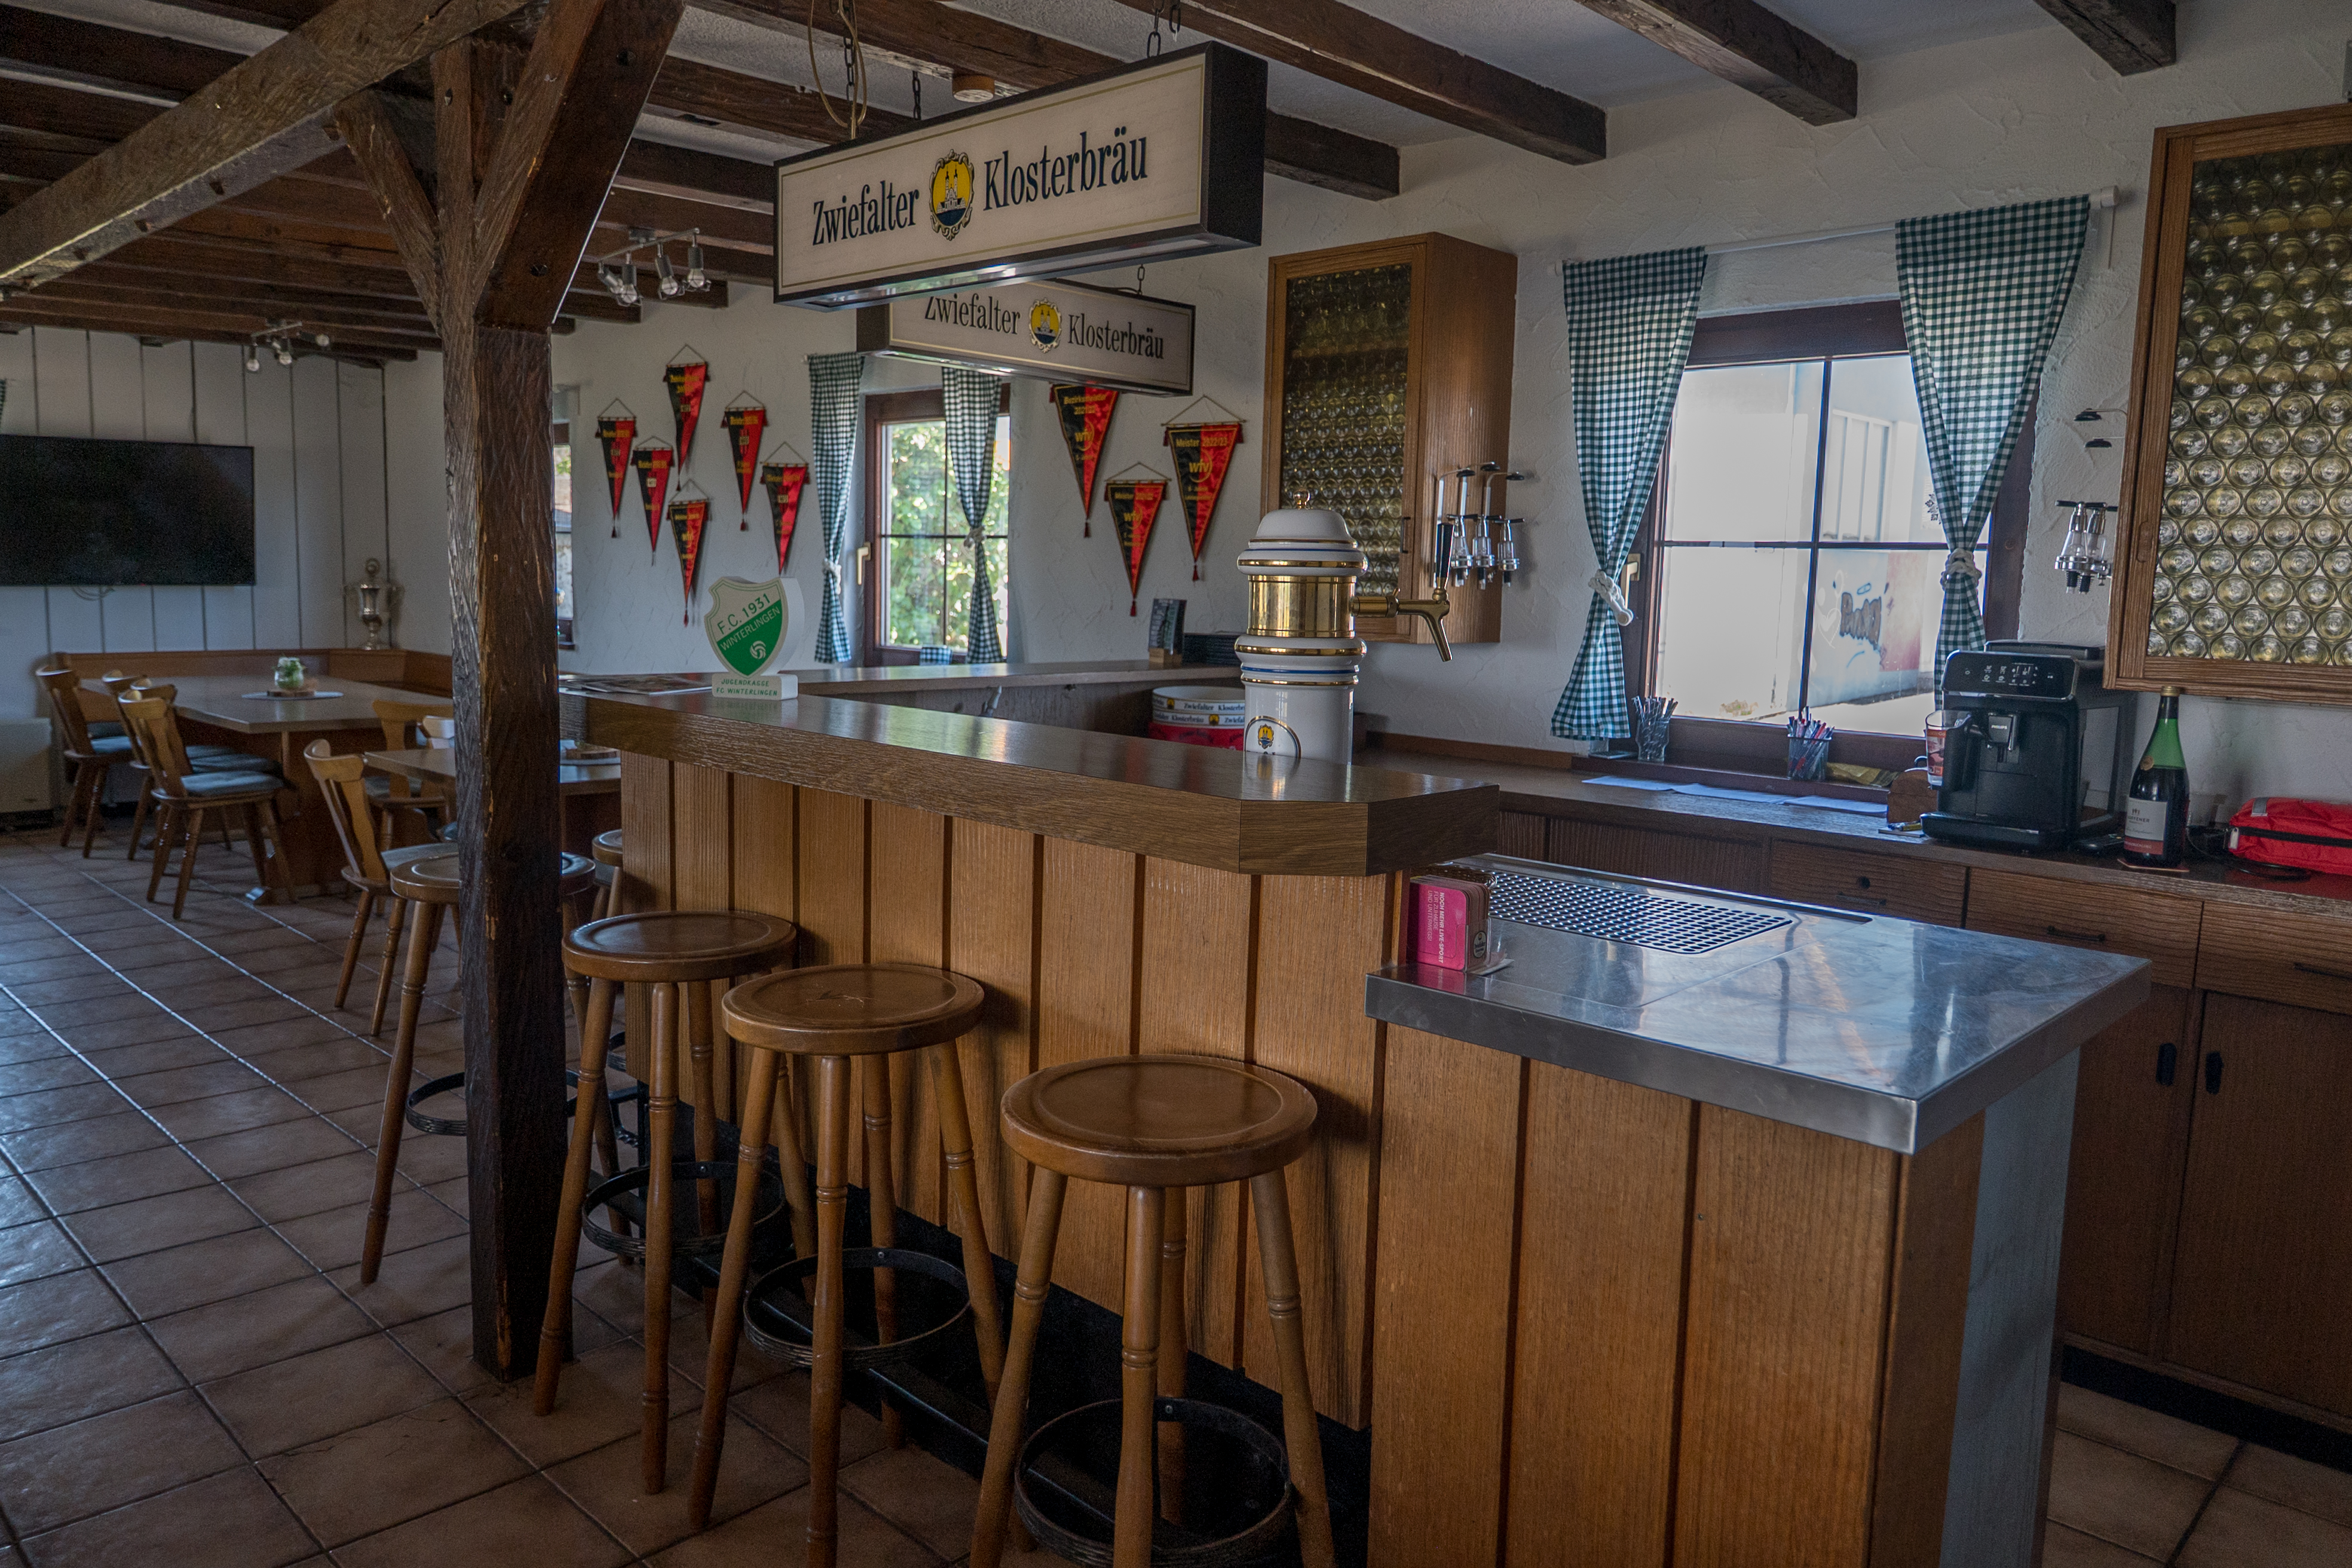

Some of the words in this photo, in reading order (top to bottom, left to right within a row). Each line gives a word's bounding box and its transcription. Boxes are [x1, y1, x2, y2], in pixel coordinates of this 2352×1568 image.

[812, 180, 920, 246] Zwiefalter
[983, 127, 1148, 212] Klosterbräu
[925, 293, 1021, 335] Zwiefalter
[1068, 314, 1165, 360] Klosterbräu
[1175, 439, 1200, 447] Meister
[1189, 458, 1210, 473] wfv
[718, 614, 742, 635] F.C.
[742, 593, 771, 618] 1931
[720, 606, 781, 651] WINTERLINGEN
